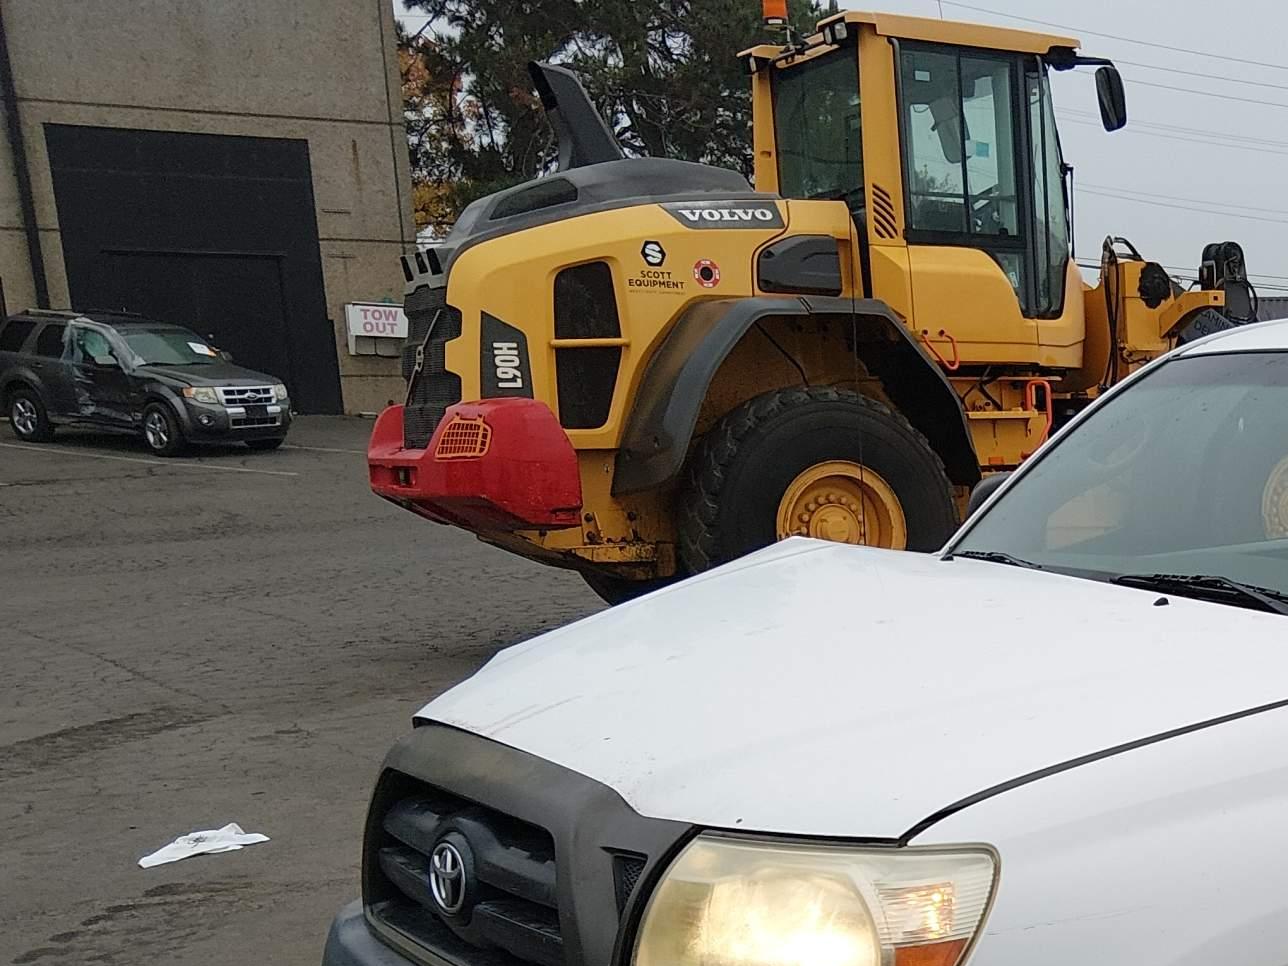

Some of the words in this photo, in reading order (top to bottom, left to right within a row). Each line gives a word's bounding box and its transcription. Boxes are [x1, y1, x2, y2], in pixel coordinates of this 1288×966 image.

[678, 208, 773, 222] VOLVO
[640, 270, 672, 280] SCOTT
[628, 278, 685, 289] EQUIPMENT
[360, 308, 398, 322] TOW
[362, 321, 398, 335] OUT
[492, 341, 523, 388] L90H
